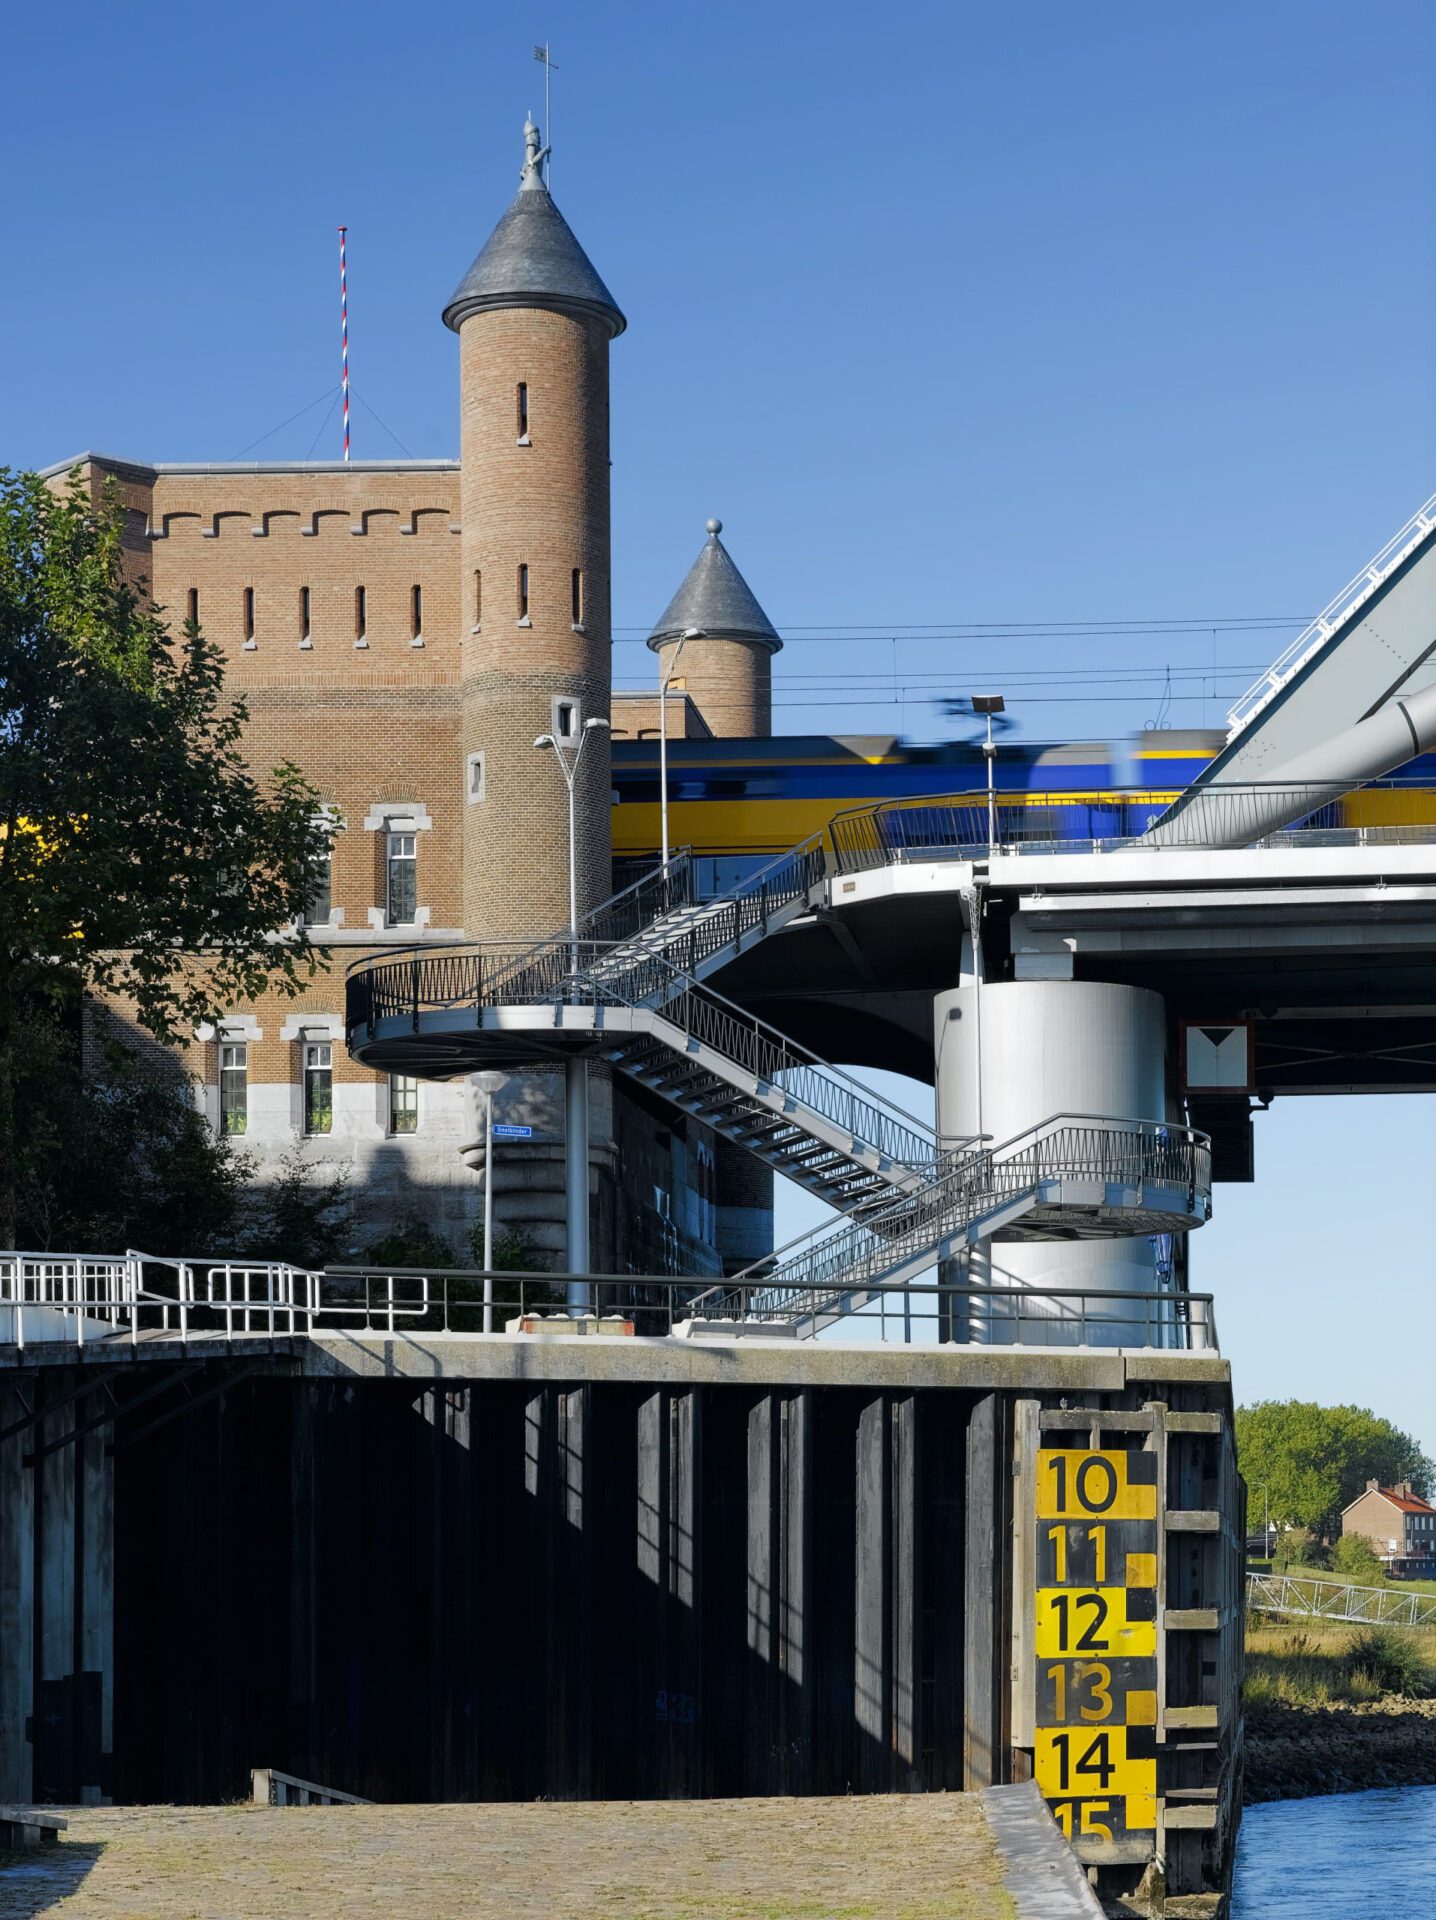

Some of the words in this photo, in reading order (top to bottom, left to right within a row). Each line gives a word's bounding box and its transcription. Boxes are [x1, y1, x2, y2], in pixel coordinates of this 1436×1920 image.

[1048, 1455, 1118, 1514] 10
[1048, 1525, 1106, 1582] 11
[1050, 1593, 1109, 1652] 12
[1047, 1662, 1113, 1721] 13
[1052, 1732, 1116, 1790] 14
[1054, 1801, 1114, 1849] 15
